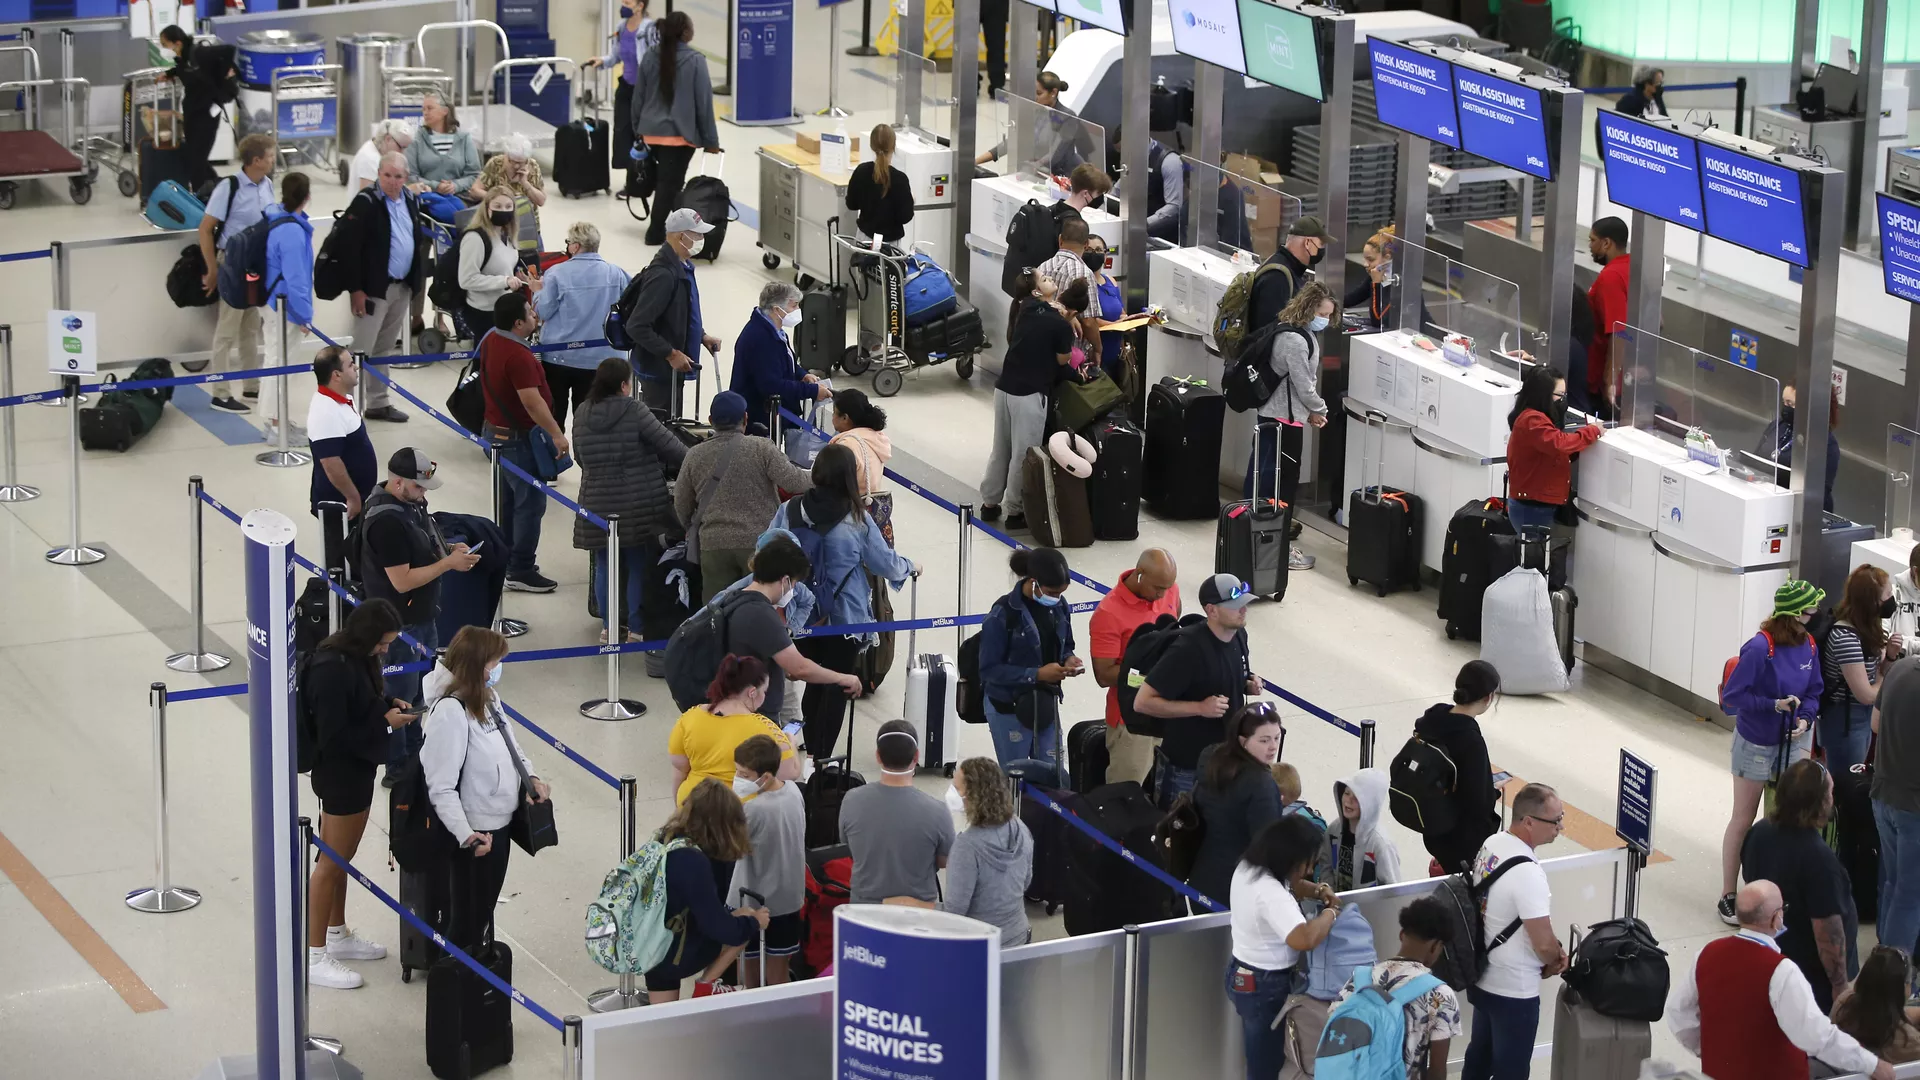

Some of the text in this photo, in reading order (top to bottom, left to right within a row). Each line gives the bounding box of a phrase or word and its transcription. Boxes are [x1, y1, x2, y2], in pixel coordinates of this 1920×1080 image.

[1197, 18, 1226, 34] MOSAIC
[1269, 41, 1289, 59] MINT
[1374, 51, 1436, 81] KIOSK ASSISTANCE
[1377, 73, 1426, 95] ASISTENCIA DE KIOSCO
[1459, 79, 1526, 110] KIOSK ASSISTANCE
[1463, 101, 1514, 124] ASISTENCIA DE KIOSCO
[1437, 125, 1454, 138] jetBlue
[1606, 125, 1679, 160] KIOSK ASSISTANCE
[1526, 154, 1543, 168] jetBlue
[1609, 149, 1666, 174] ASISTENCIA DE KIOSCO
[1706, 157, 1782, 192] KIOSK ASSISTANCE
[1708, 181, 1768, 207] ASISTENCIA DE KIOSCO
[1679, 206, 1698, 220] jetBlue
[1781, 240, 1801, 255] jetBlue
[889, 274, 900, 336] smartecarte
[567, 341, 585, 349] jetBlue
[206, 374, 223, 382] jetBlue
[23, 394, 42, 402] jetBlue
[1072, 602, 1094, 613] jetBlue
[797, 627, 813, 635] Blue
[932, 618, 954, 627] jetBlue
[600, 644, 620, 653] jetBlue
[382, 665, 403, 675] jetBlue
[843, 942, 886, 968] jetBlue
[844, 1000, 929, 1038] SPECIAL
[844, 1025, 943, 1064] SERVICES
[849, 1057, 892, 1078] Wheelchair
